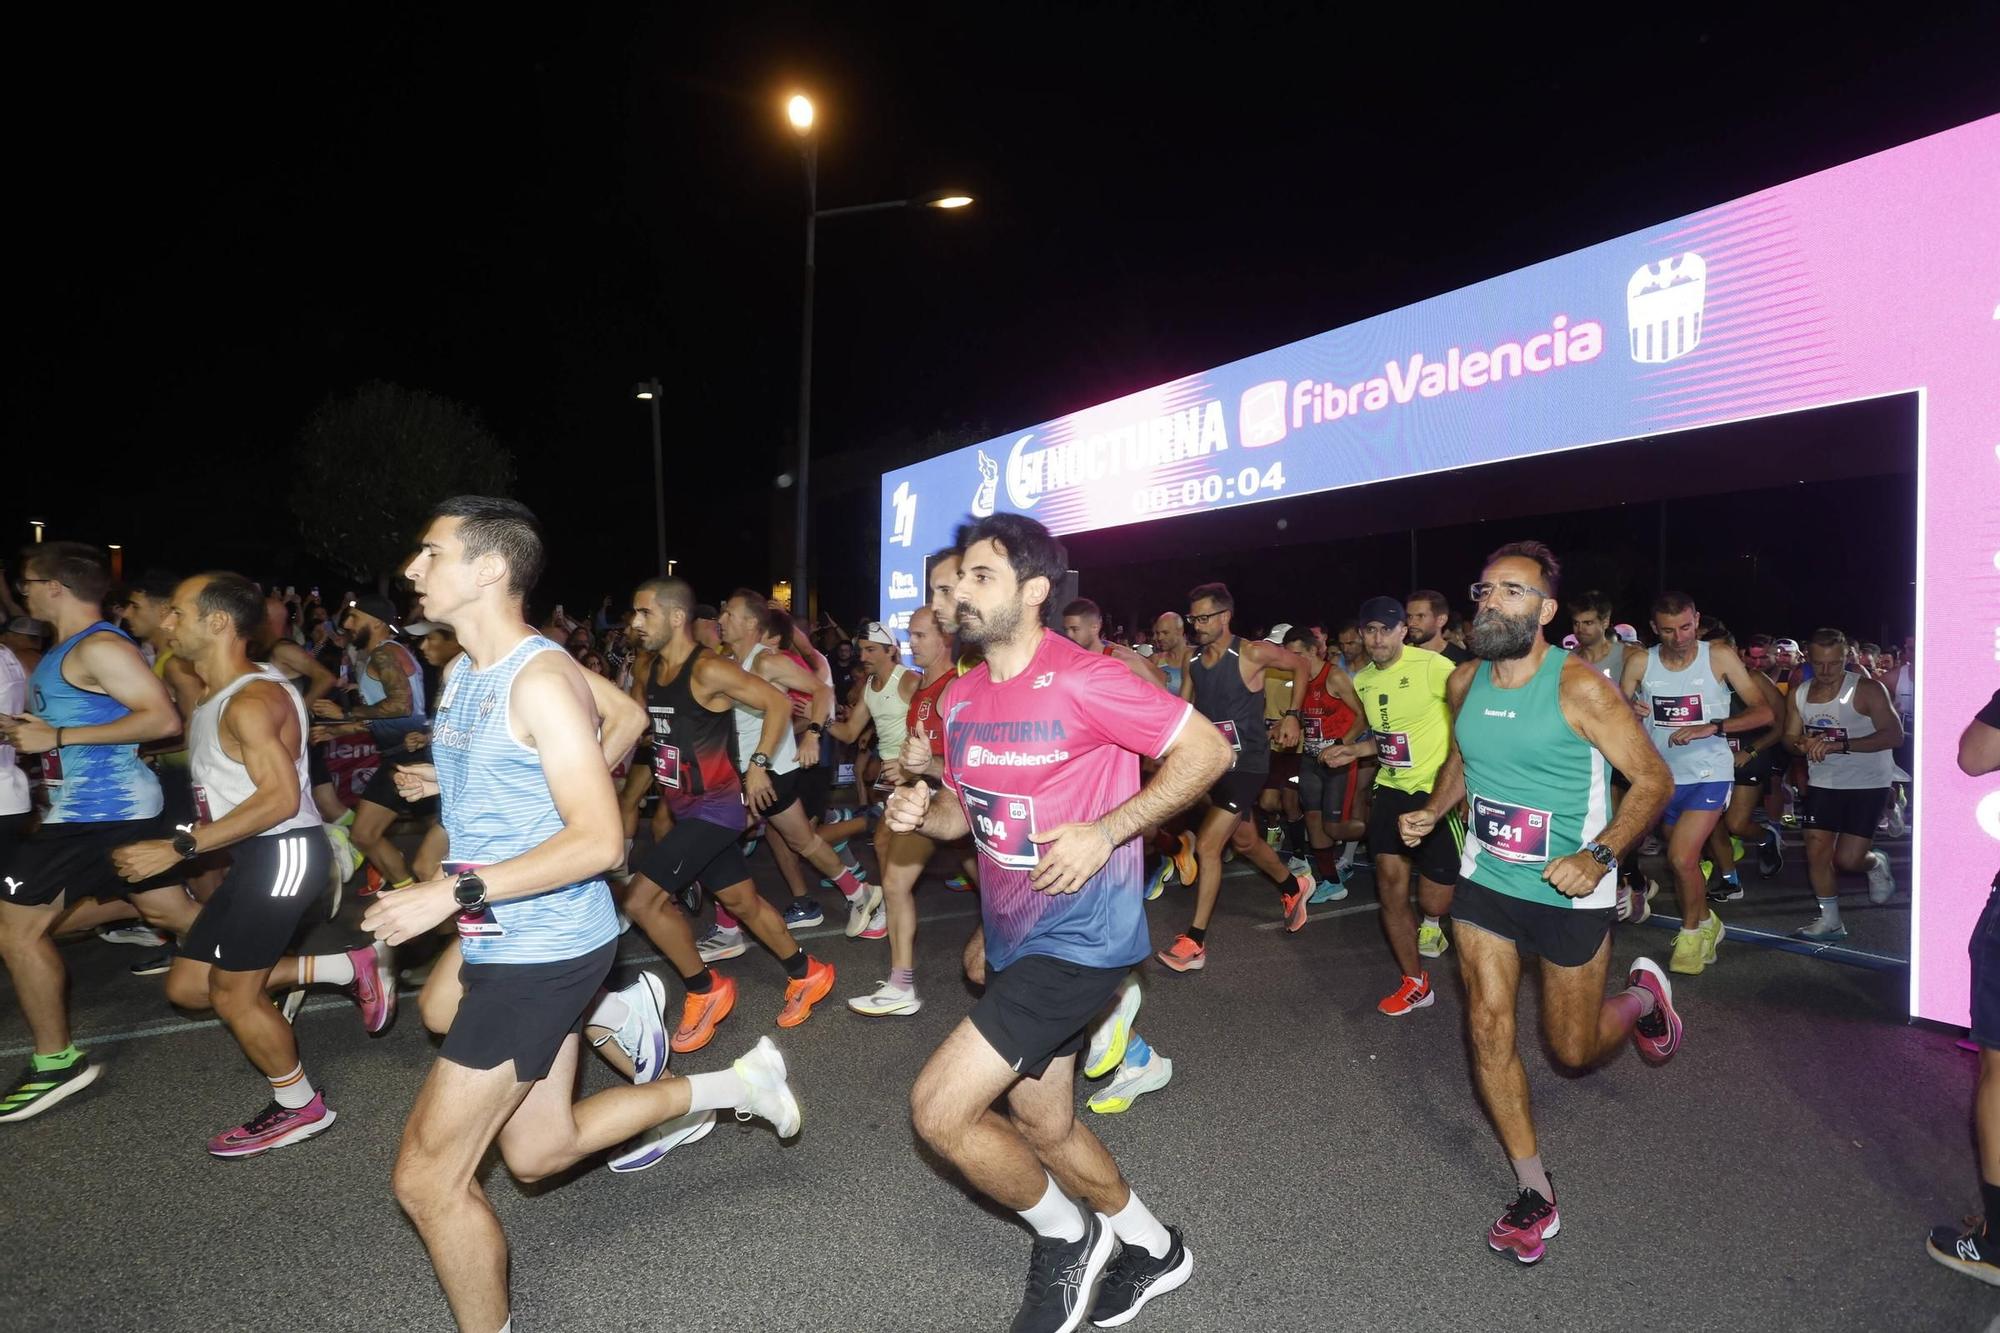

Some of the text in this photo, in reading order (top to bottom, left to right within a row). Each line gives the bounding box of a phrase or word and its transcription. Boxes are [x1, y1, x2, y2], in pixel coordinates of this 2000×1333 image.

[1291, 314, 1604, 429] fibraValencia
[1047, 400, 1229, 491] NOCTURNA
[1663, 707, 1690, 717] 738
[974, 719, 1067, 744] NOCTURNA
[980, 749, 1070, 767] fibraValencia
[976, 814, 1008, 841] 194
[1488, 820, 1522, 842] 541
